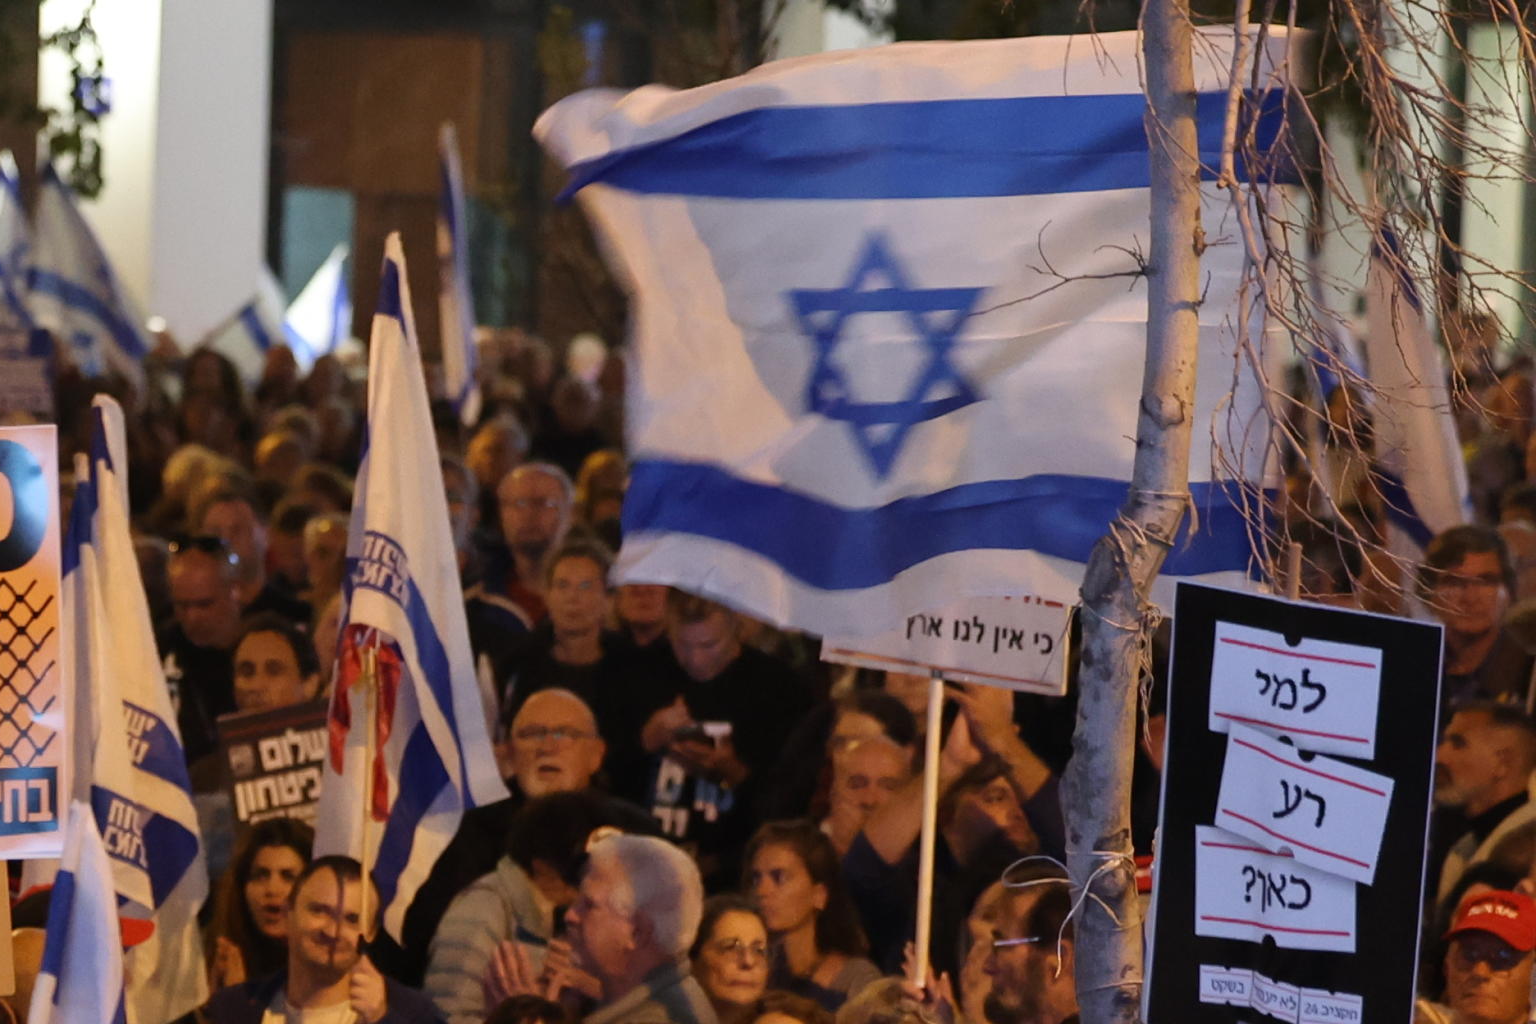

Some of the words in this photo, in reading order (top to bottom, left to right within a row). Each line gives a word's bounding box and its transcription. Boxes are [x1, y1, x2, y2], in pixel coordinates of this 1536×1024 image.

[952, 615, 984, 644] לנו
[993, 626, 1024, 653] אין
[1033, 632, 1053, 655] כי
[1255, 667, 1326, 714] למי
[1272, 779, 1326, 829] רע
